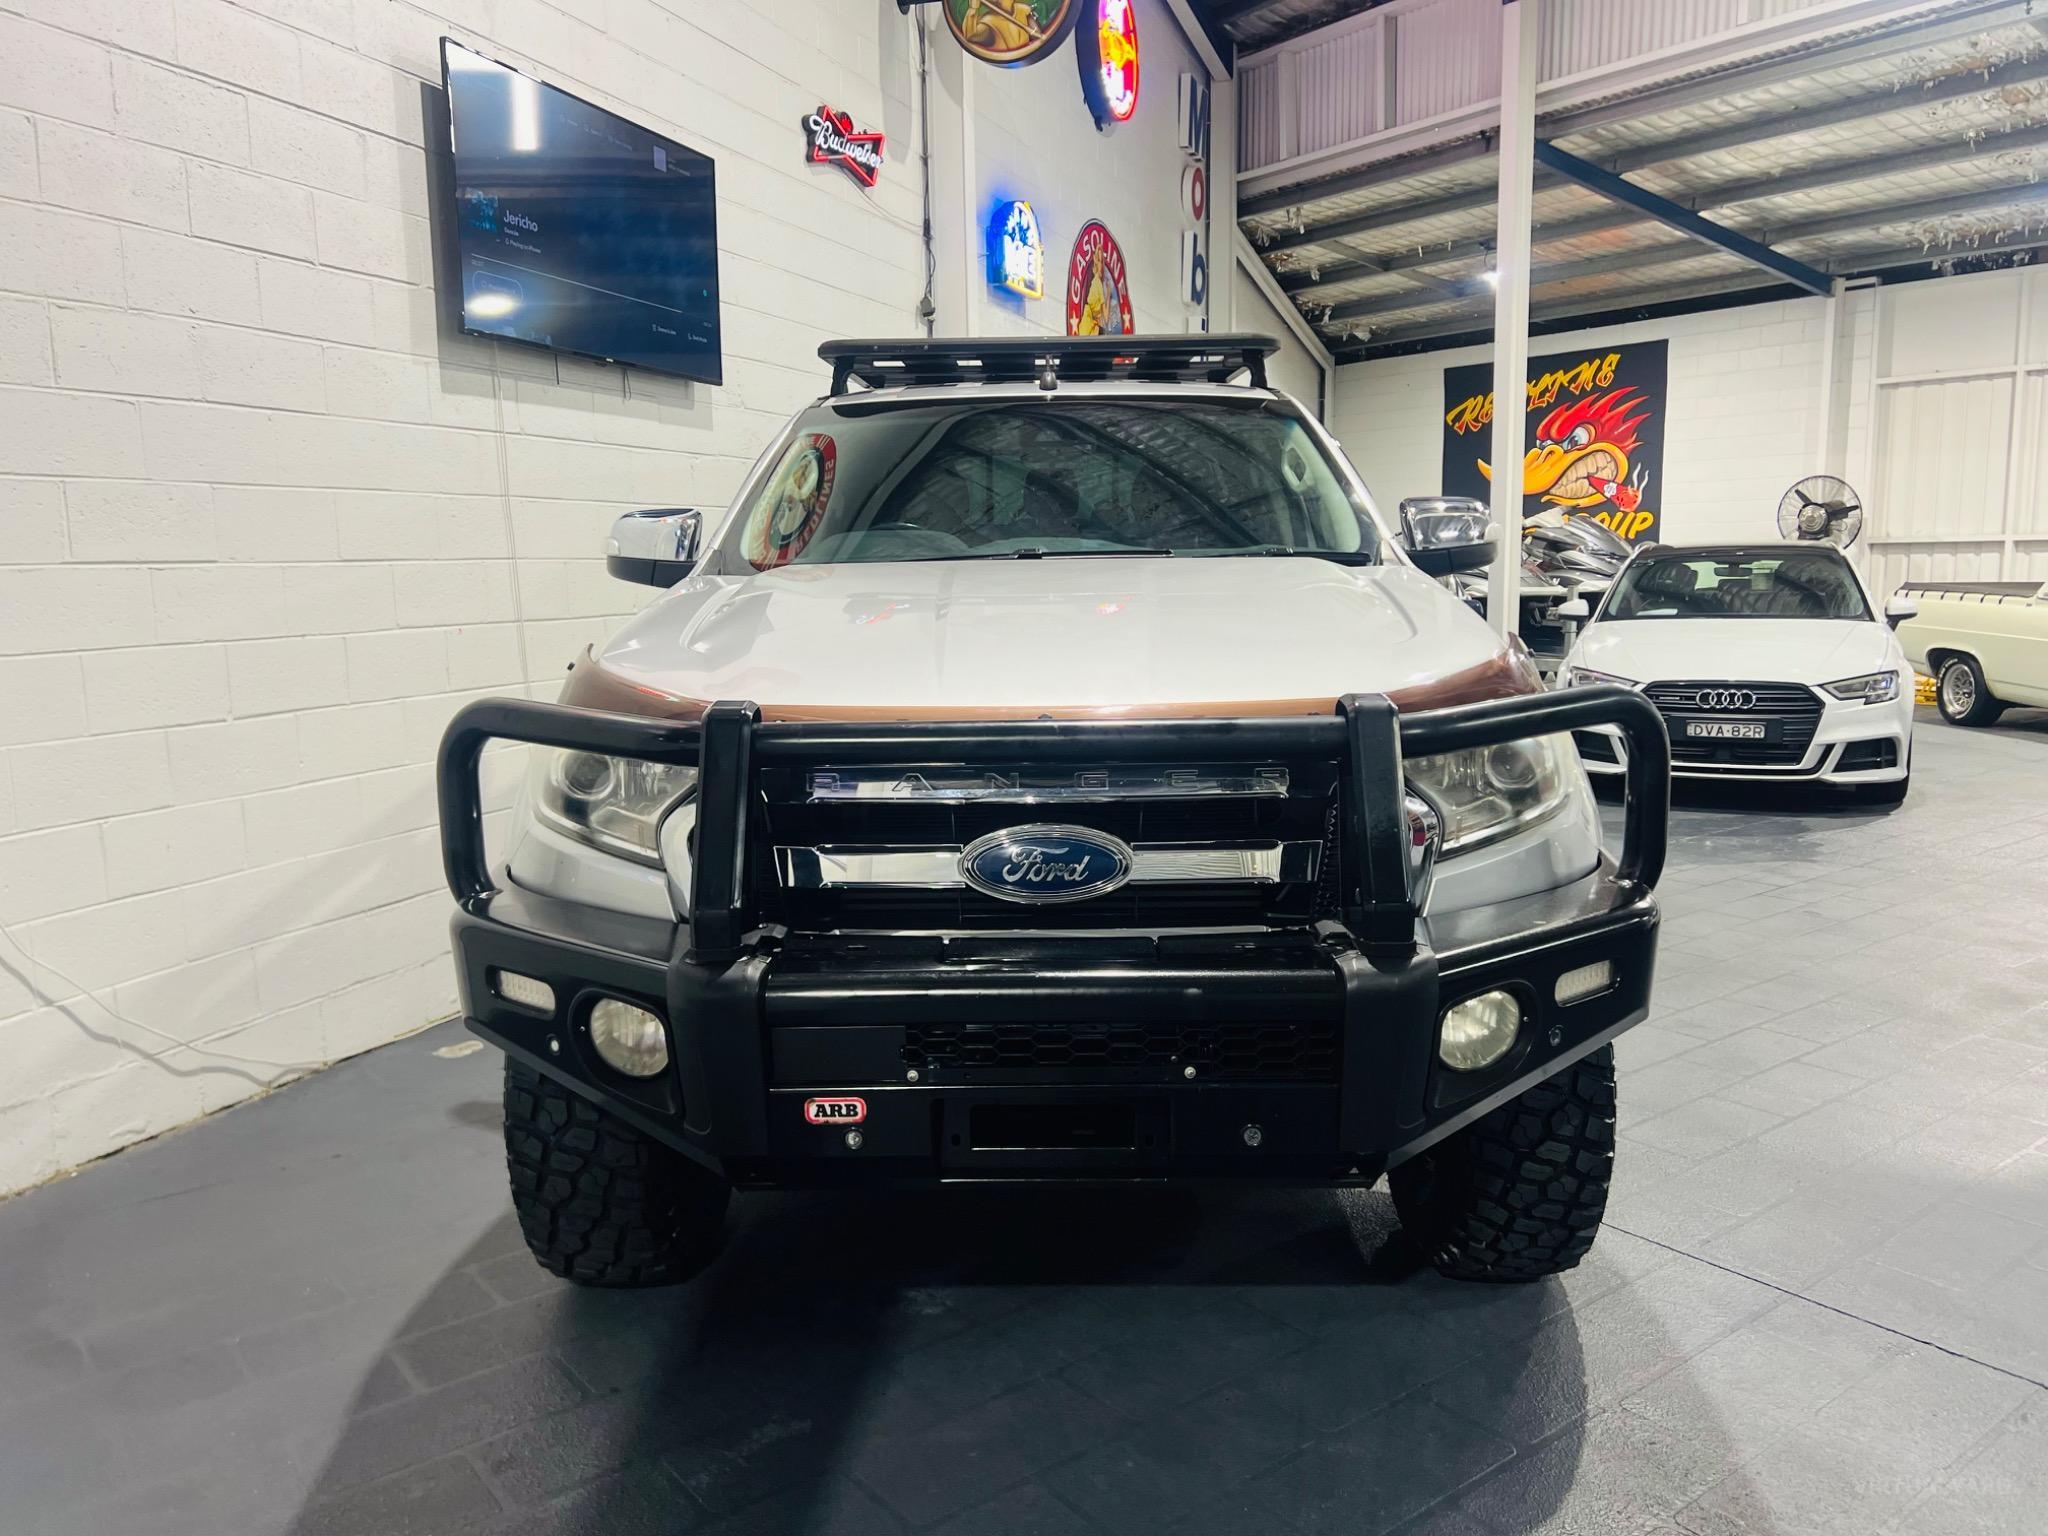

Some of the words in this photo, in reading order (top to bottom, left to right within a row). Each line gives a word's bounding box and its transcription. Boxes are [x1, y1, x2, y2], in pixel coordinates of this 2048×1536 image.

[503, 209, 538, 232] Jericho
[1070, 229, 1127, 304] GASOLINE
[1446, 353, 1621, 436] RELINE
[806, 767, 1289, 793] RANGER
[1002, 846, 1088, 883] Ford
[813, 1103, 859, 1118] ARB
